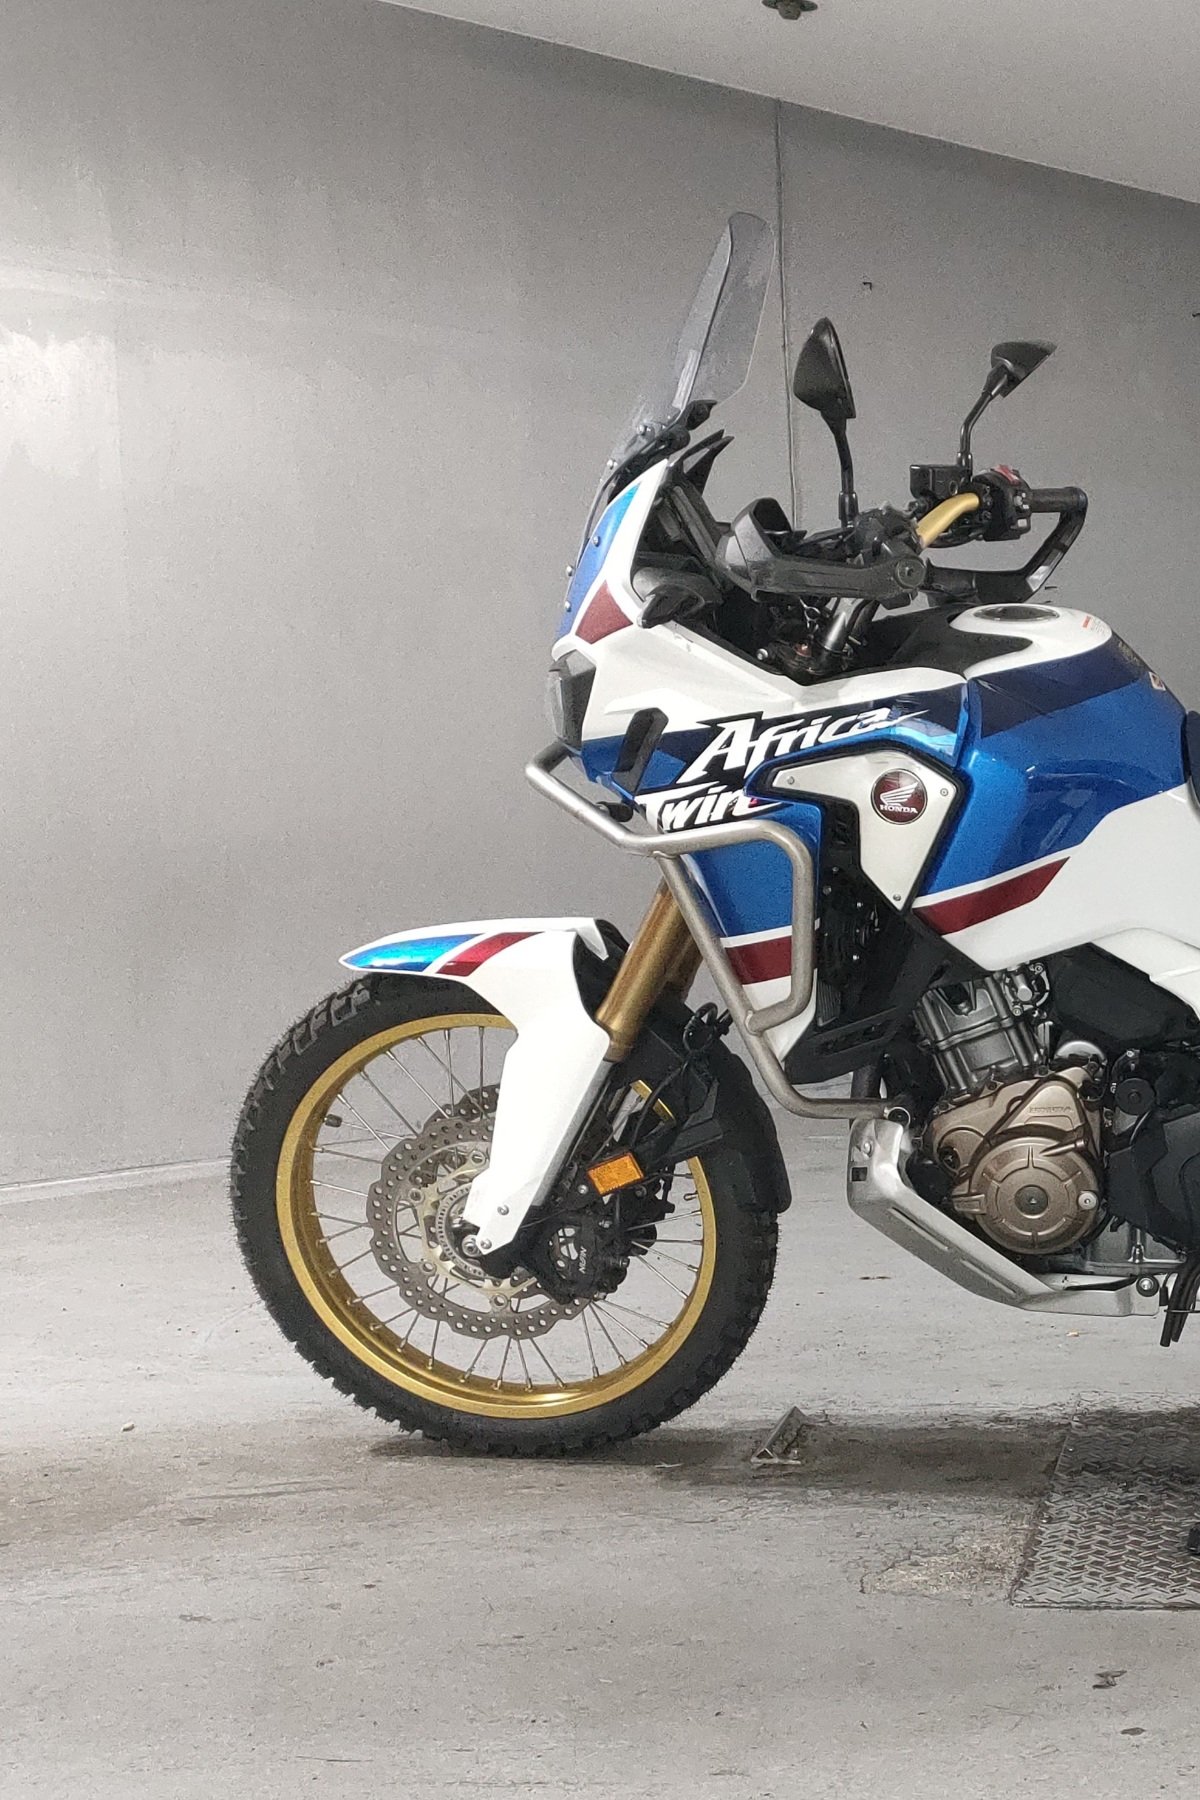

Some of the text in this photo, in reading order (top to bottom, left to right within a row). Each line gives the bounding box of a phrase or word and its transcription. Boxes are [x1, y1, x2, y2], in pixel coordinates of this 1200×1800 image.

[675, 709, 930, 785] Africa
[634, 781, 783, 833] Twin
[880, 804, 919, 814] HONDA
